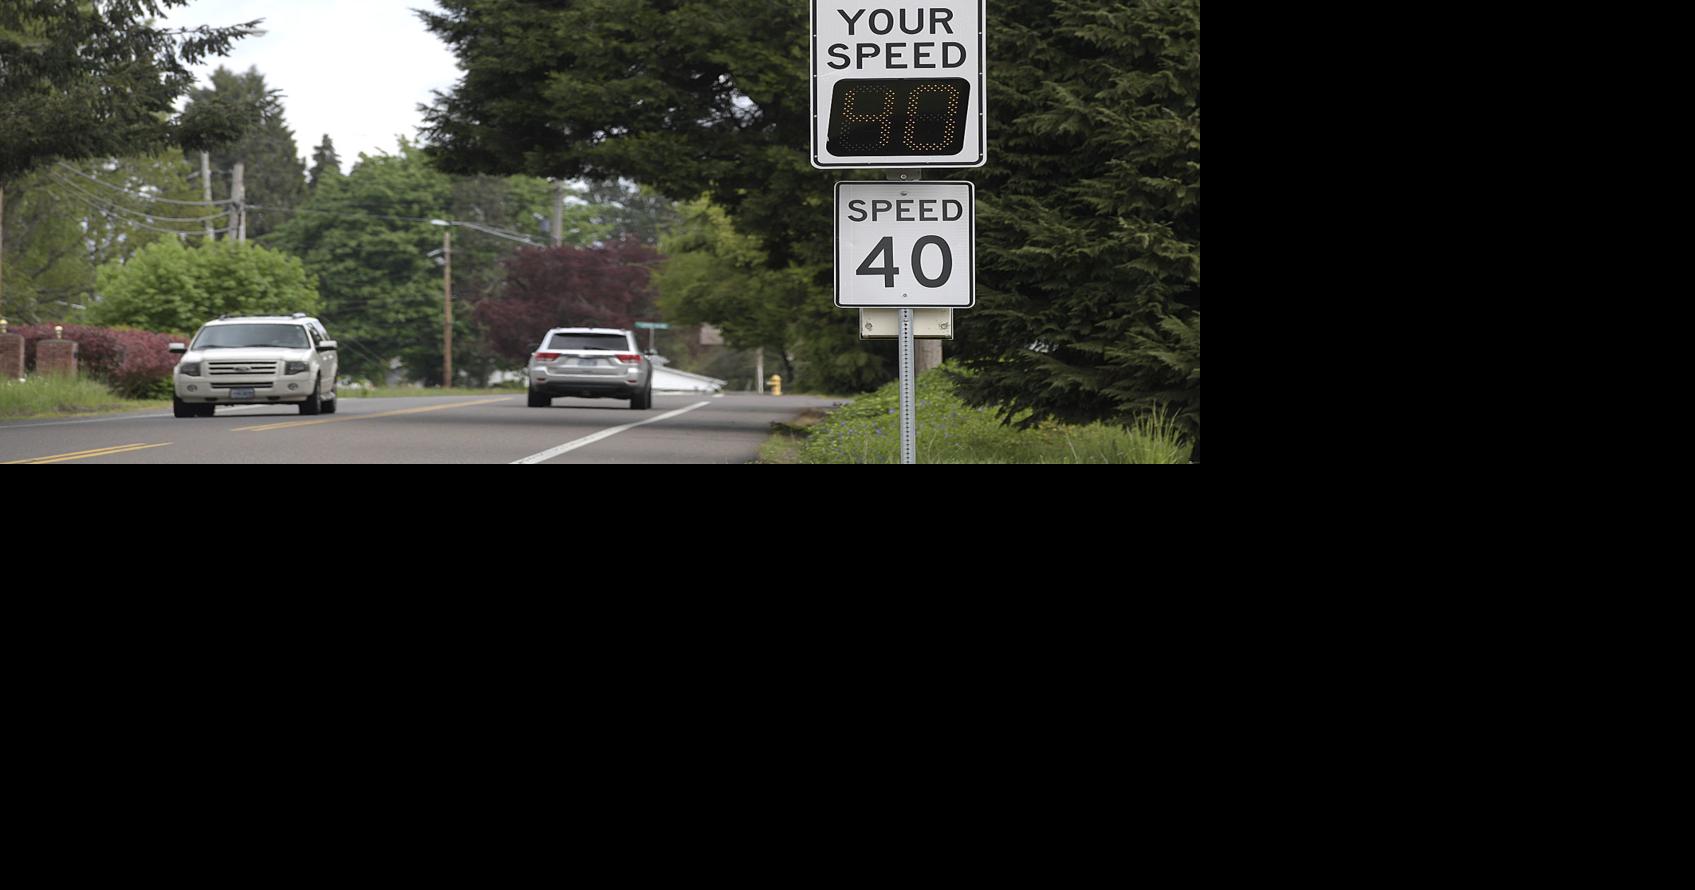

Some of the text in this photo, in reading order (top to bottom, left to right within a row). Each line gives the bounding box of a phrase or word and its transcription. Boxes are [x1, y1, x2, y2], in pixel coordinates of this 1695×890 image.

[837, 8, 954, 35] YOUR
[827, 42, 967, 69] SPEED
[842, 84, 960, 150] 40
[848, 199, 963, 222] SPEED
[856, 234, 952, 288] 40
